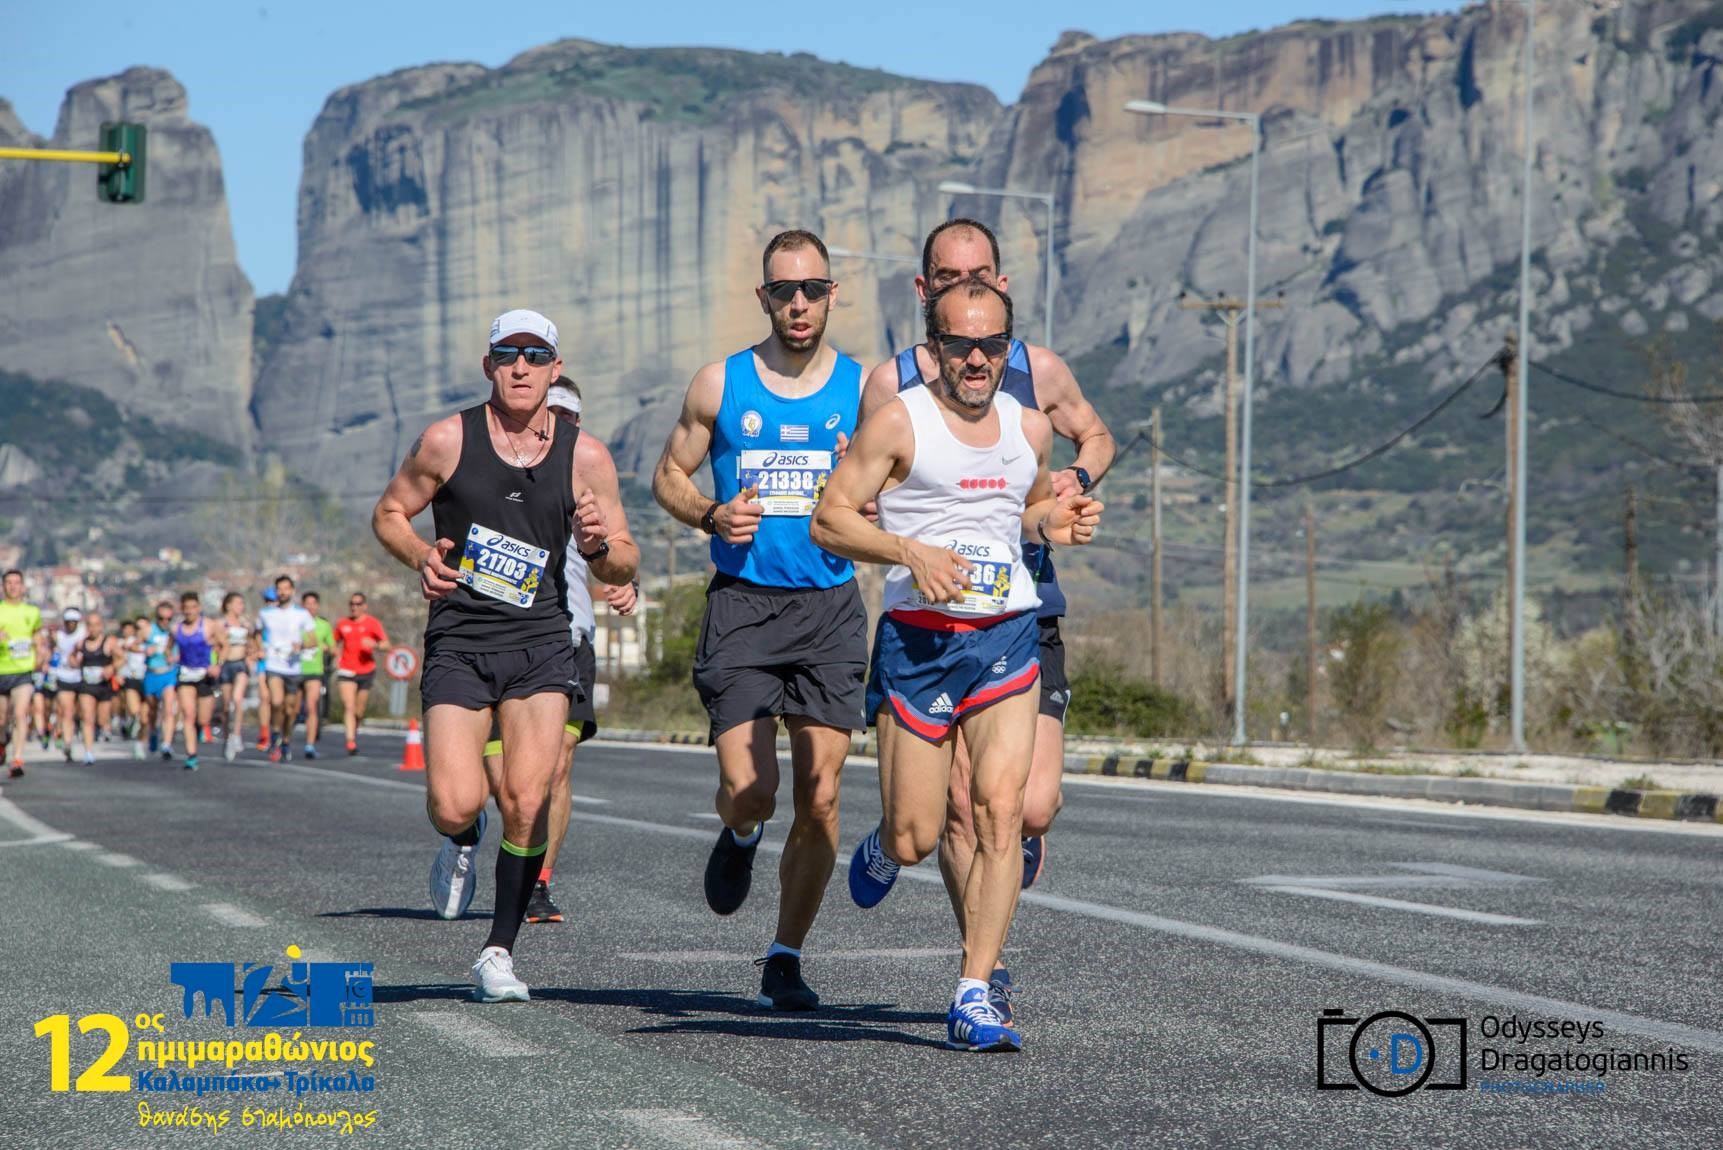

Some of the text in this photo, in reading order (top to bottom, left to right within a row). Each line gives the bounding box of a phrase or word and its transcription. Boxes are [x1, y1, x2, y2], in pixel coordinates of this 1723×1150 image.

[778, 455, 809, 466] asics
[758, 471, 814, 490] 21338
[501, 539, 532, 558] asics
[957, 543, 990, 557] asics
[477, 548, 528, 581] 21703
